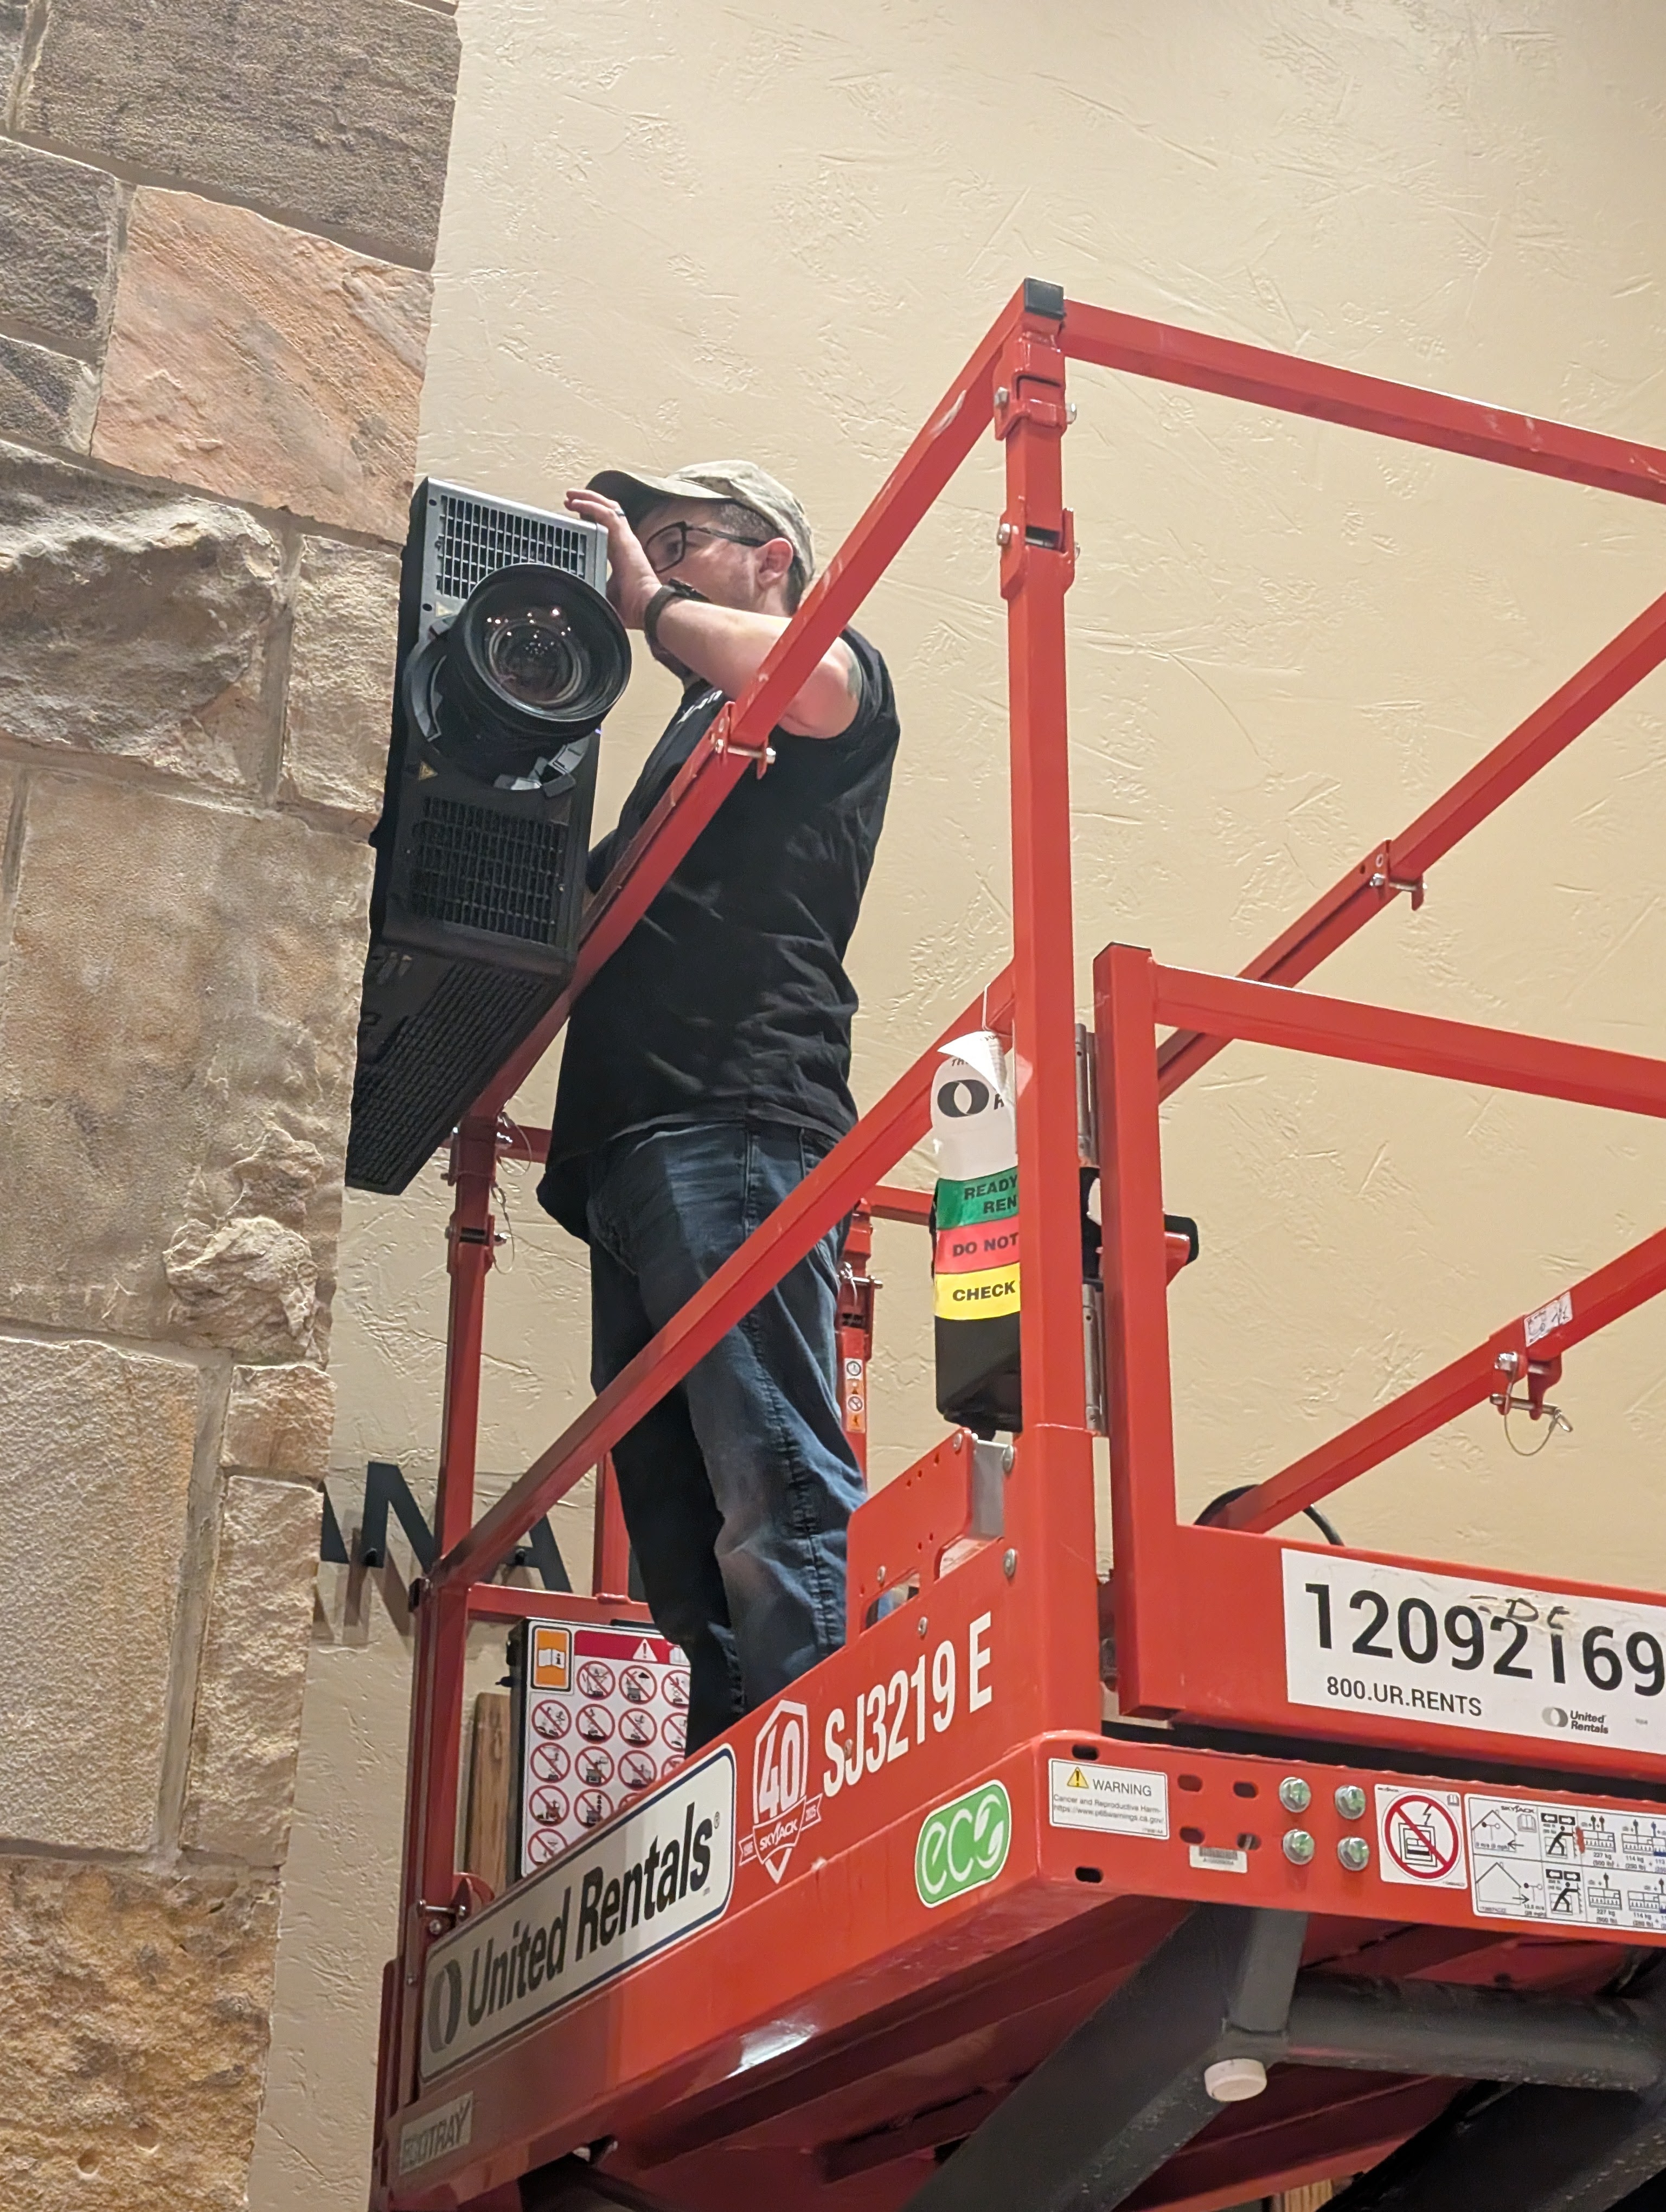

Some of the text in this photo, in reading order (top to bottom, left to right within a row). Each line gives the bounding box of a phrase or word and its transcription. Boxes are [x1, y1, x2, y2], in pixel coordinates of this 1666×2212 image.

[964, 1174, 1017, 1200] READY
[953, 1232, 1018, 1257] DO NOT
[952, 1280, 1016, 1301] CHECK
[823, 1611, 992, 1797] SJ3219 E
[1327, 1676, 1482, 1716] 800.UR.RENTS
[1570, 1710, 1605, 1724] United
[1571, 1720, 1609, 1734] Rentals
[759, 1720, 800, 1818] 40
[1092, 1779, 1152, 1797] WARNING
[1054, 1794, 1077, 1802] Cancer
[1094, 1799, 1139, 1811] Reproductive
[467, 1802, 713, 2027] United Rentals
